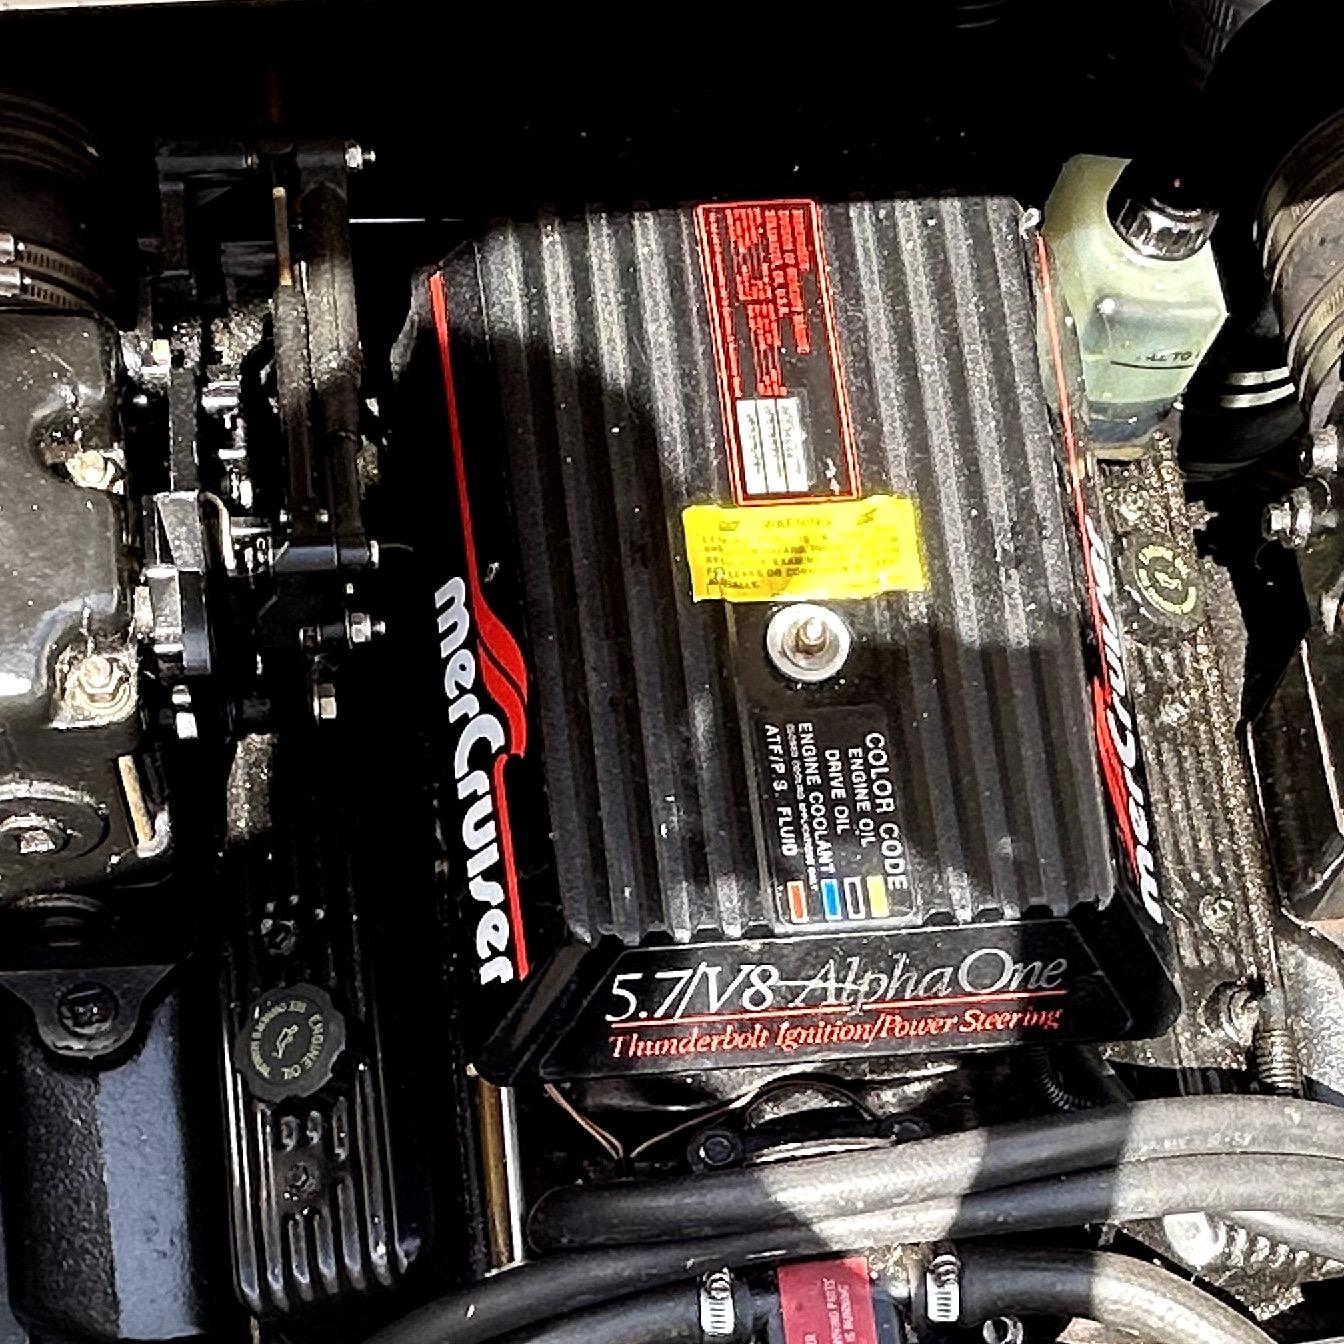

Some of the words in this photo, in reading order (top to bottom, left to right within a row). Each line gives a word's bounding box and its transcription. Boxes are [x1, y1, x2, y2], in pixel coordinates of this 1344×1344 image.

[798, 722, 822, 786] ENGINE
[824, 749, 847, 800] DRIVE
[848, 747, 872, 813] ENGINE
[864, 732, 896, 814] COLOR
[776, 806, 799, 857] FLUID
[808, 791, 836, 874] COOLANT
[834, 805, 851, 836] OIL
[858, 818, 877, 848] OIL
[878, 822, 908, 891] CODE
[776, 952, 953, 1016] Alpha
[959, 947, 1068, 995] One
[608, 1019, 770, 1059] Thunderbolt
[774, 1011, 958, 1051] Ignition/Power
[958, 1005, 1065, 1034] Steering
